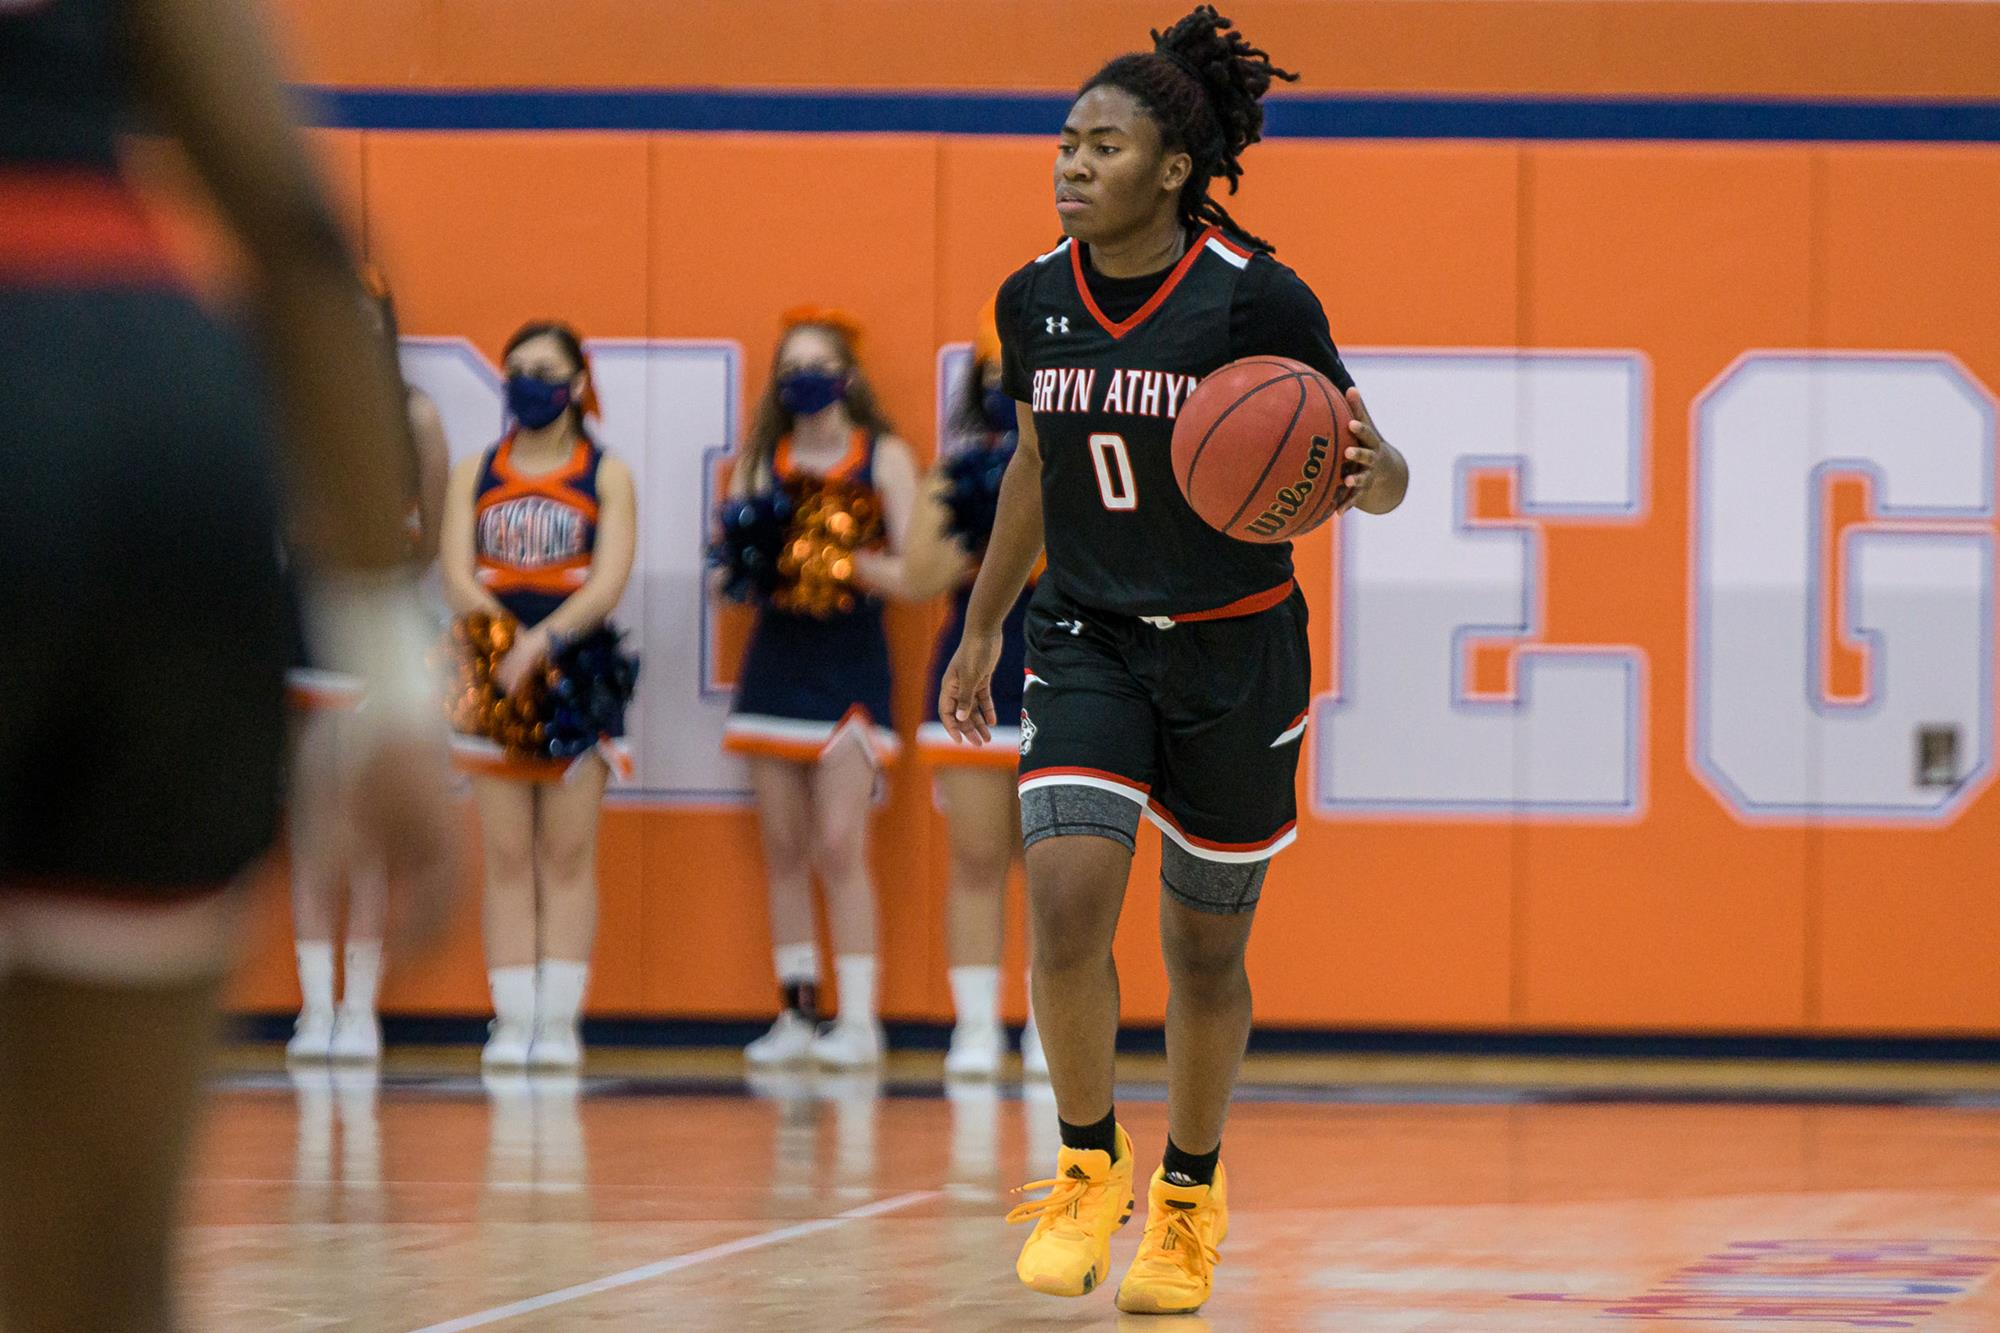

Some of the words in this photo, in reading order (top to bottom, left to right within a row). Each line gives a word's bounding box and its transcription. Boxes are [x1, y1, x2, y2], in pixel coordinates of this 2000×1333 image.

[1032, 368, 1096, 413] BRYN
[1088, 432, 1138, 511] 0
[1243, 434, 1330, 536] Wilson
